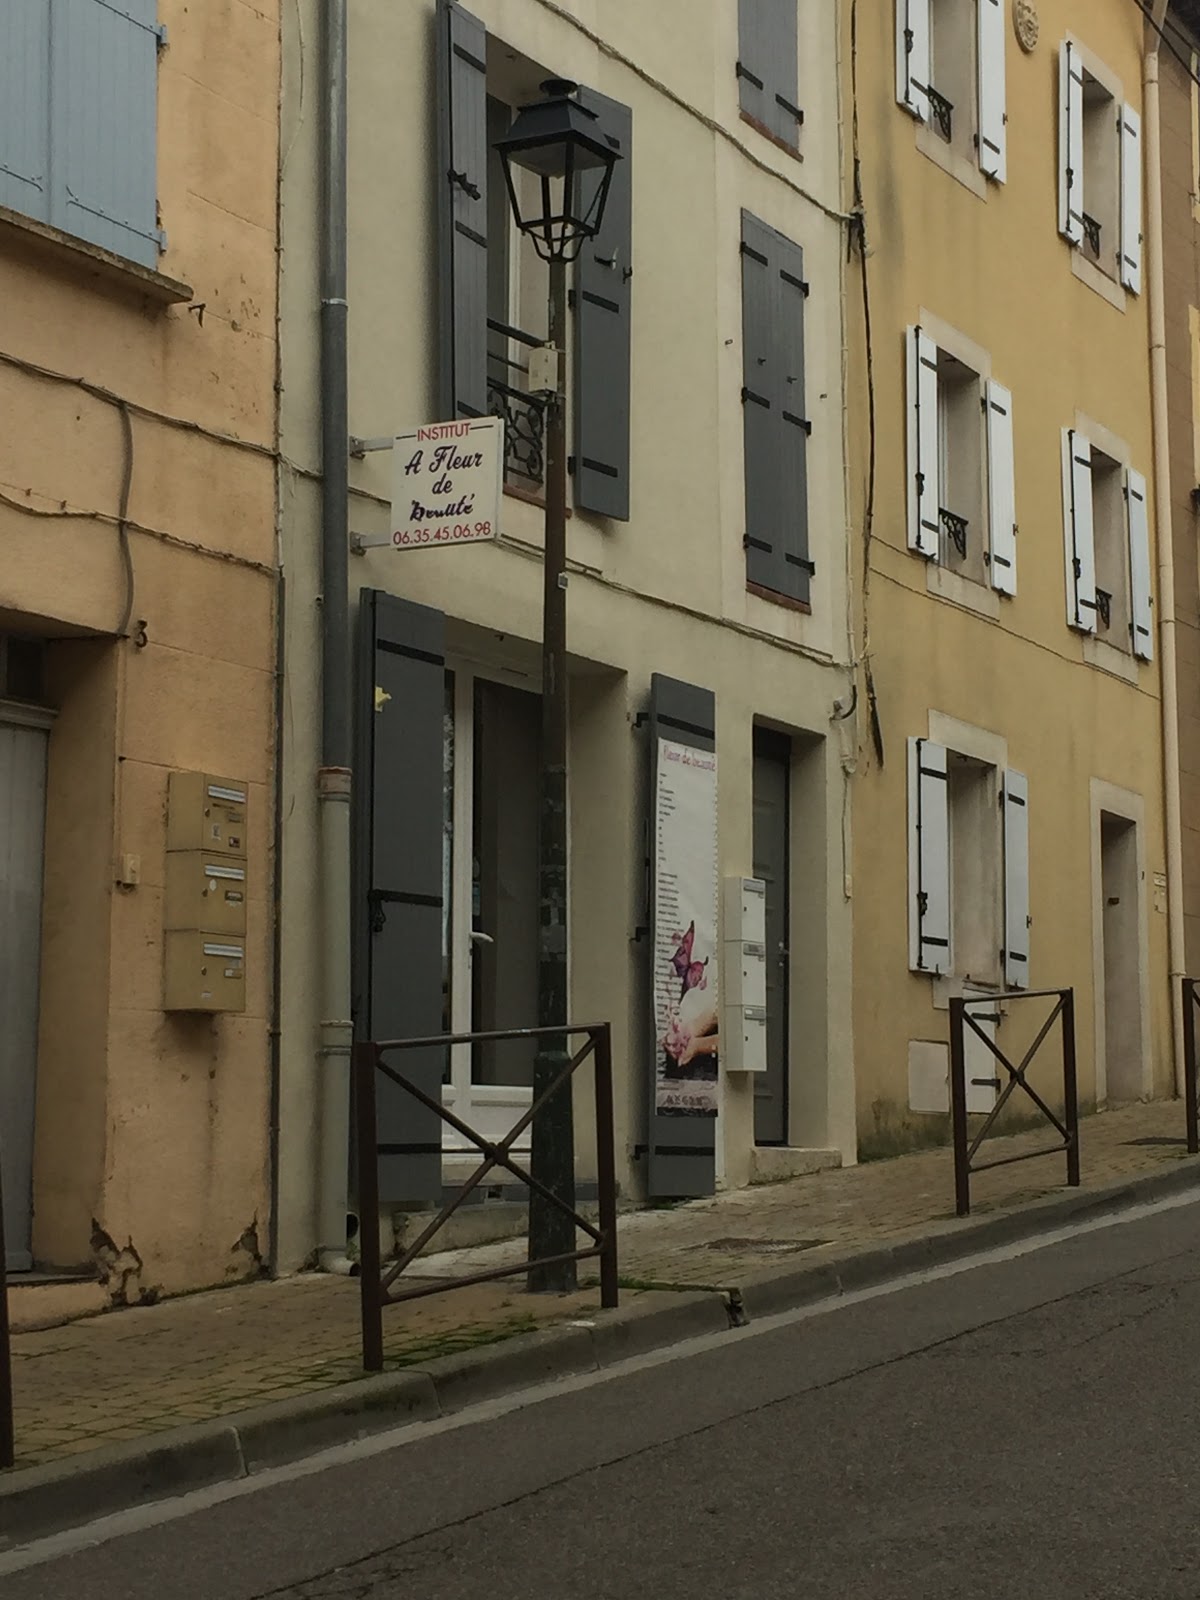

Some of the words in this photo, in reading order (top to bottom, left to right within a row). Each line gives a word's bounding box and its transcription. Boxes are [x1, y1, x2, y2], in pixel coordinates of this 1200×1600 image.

[417, 423, 471, 441] INSTITUT
[404, 449, 424, 476] A
[428, 445, 483, 473] Fleur
[431, 473, 453, 494] de
[392, 521, 491, 545] 06.35.45.06.98
